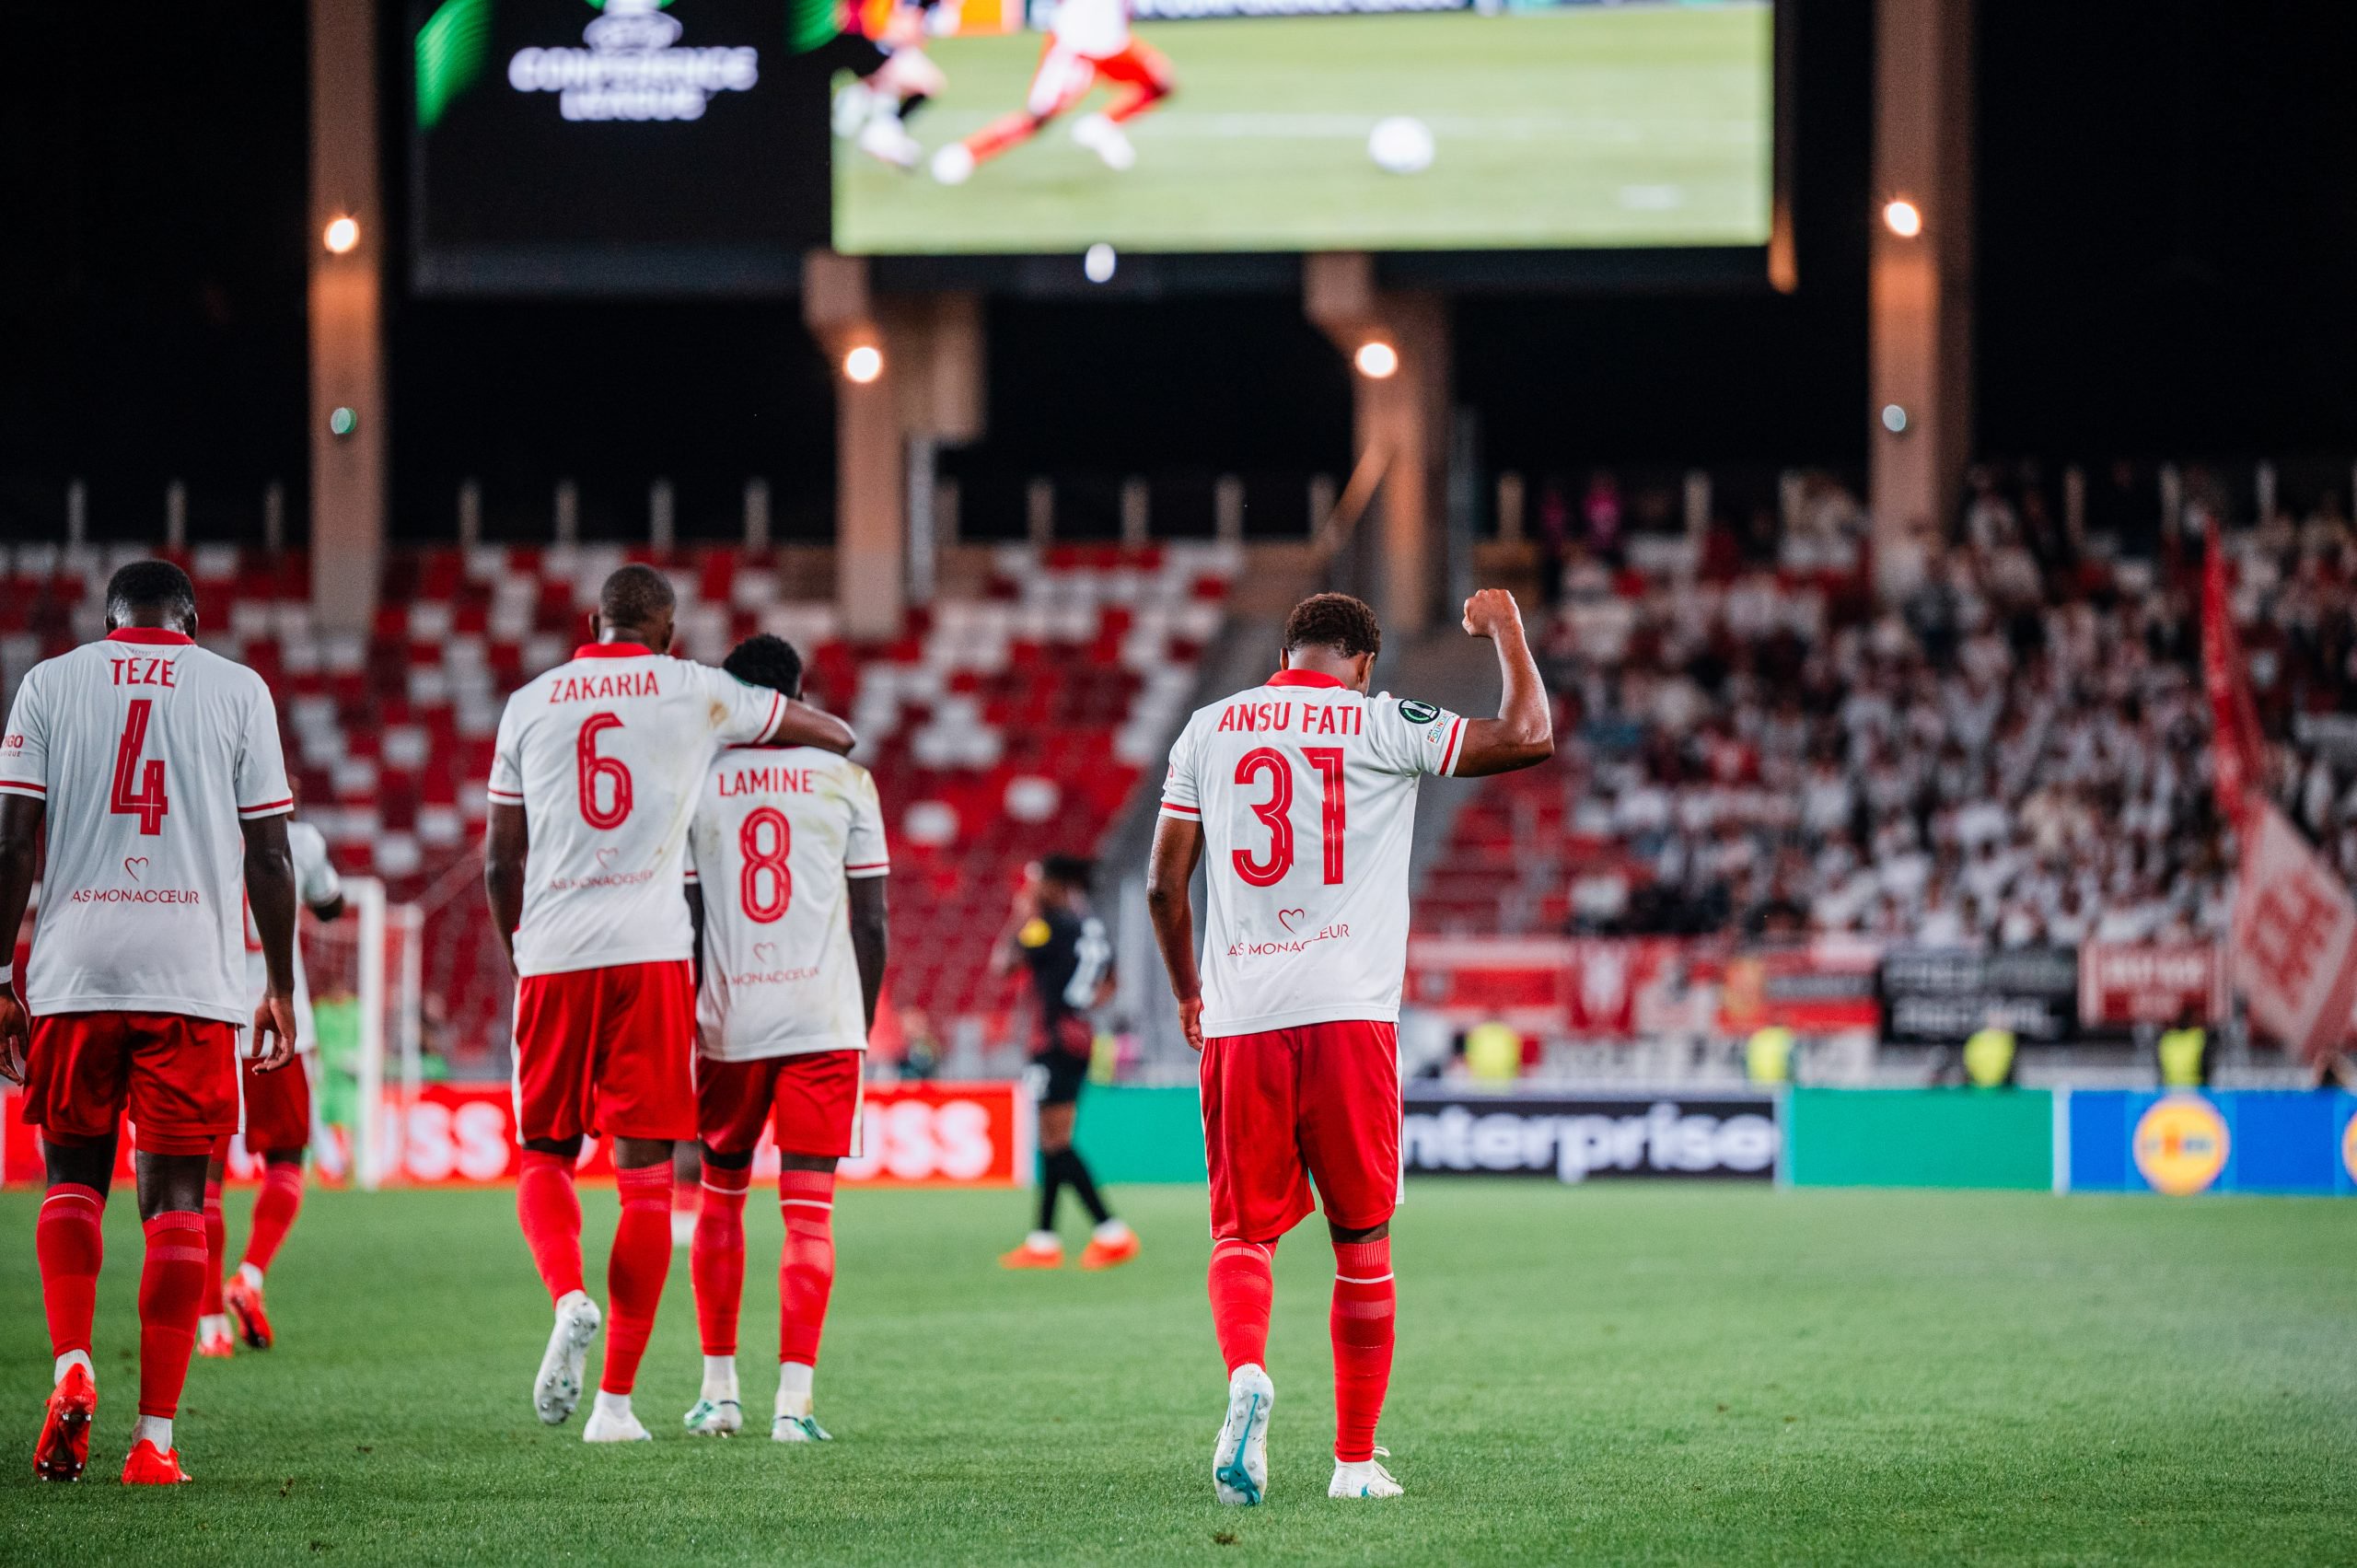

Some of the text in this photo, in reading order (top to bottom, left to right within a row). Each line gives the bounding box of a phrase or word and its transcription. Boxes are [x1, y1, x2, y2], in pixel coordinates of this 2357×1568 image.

[110, 656, 175, 688] TEZE
[549, 670, 660, 704] ZAKARIA
[1217, 701, 1362, 737] ANSU FATI
[110, 699, 169, 836] 4
[576, 711, 634, 831] 6
[717, 767, 815, 798] LAMINE
[1231, 746, 1347, 888] 31
[737, 806, 793, 925] 8
[1402, 1105, 1781, 1184] nterprise
